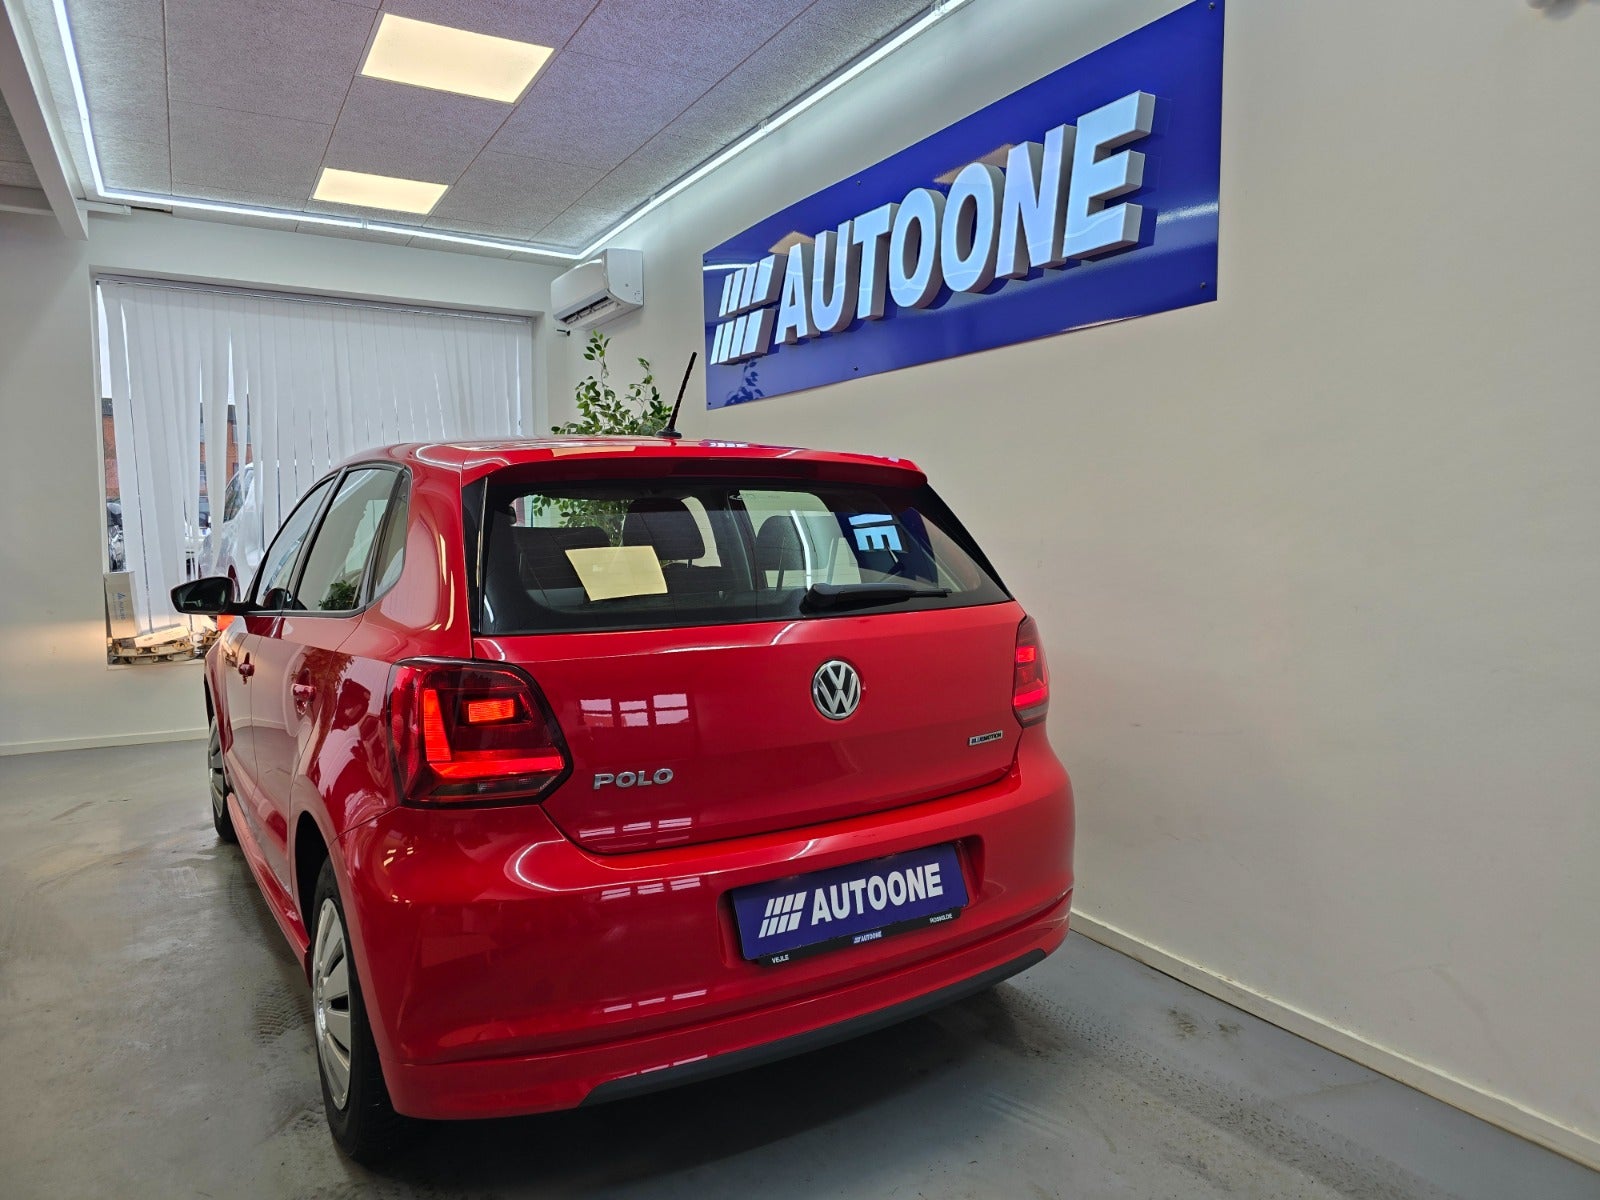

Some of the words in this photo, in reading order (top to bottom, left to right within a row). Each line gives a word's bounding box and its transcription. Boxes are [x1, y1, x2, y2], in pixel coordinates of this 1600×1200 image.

[775, 90, 1156, 345] AUTOONE
[812, 660, 861, 720] VW
[593, 768, 674, 790] POLO
[811, 863, 943, 926] AUTOONE
